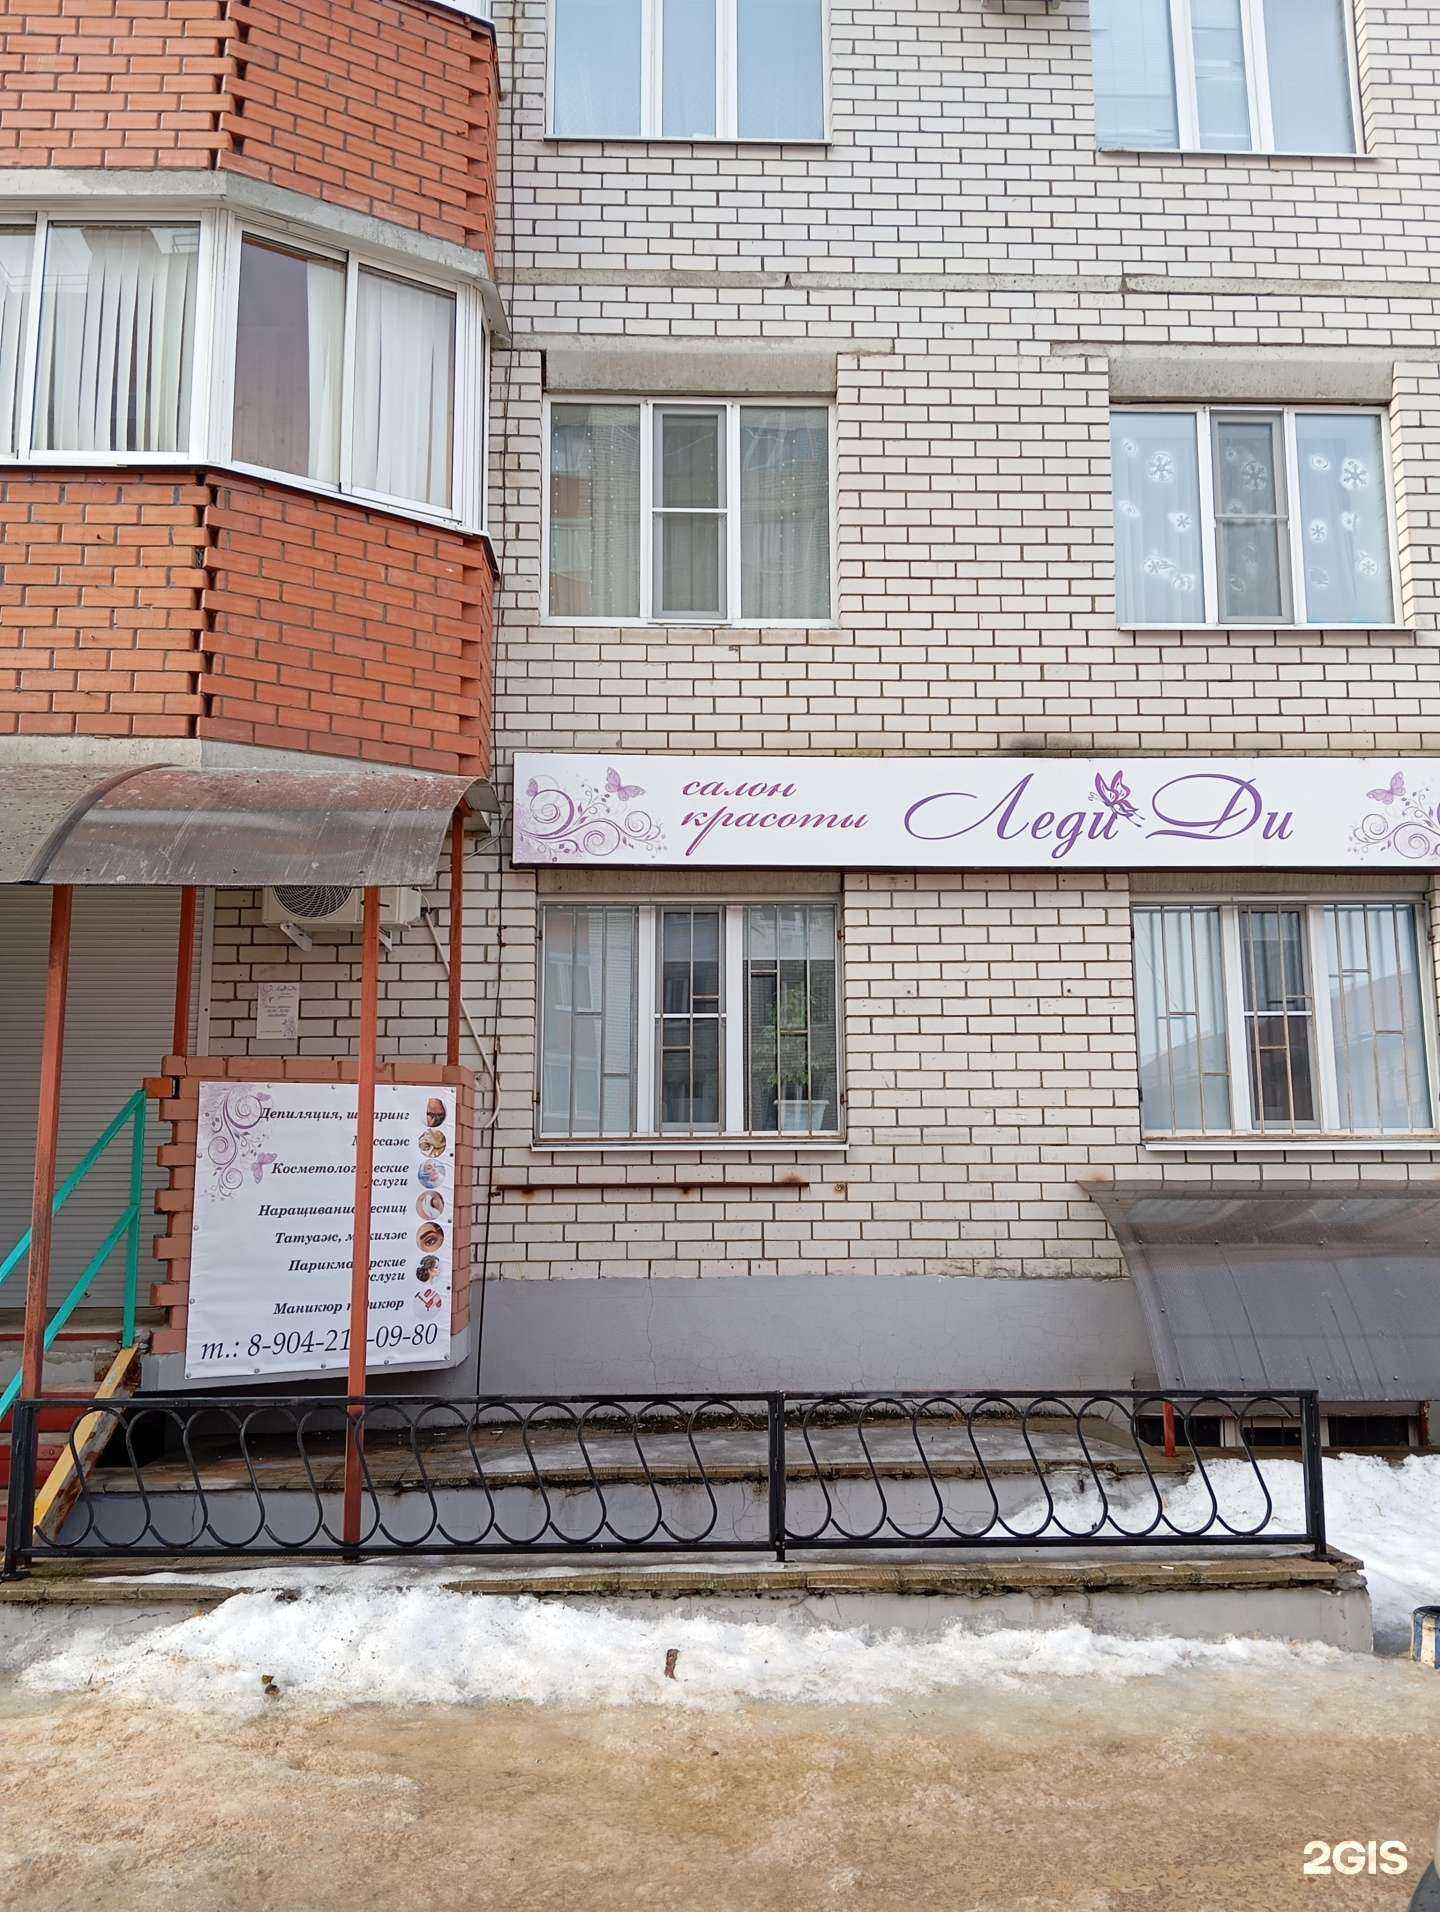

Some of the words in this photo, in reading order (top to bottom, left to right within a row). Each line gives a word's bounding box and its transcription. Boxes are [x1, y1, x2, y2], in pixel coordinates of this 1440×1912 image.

[682, 780, 797, 797] салон
[904, 773, 1118, 859] Леди
[1145, 773, 1294, 840] Ди
[681, 806, 868, 856] красоты
[259, 1107, 343, 1121] Депиляция,
[272, 1163, 410, 1174] Косметологеские
[370, 1178, 408, 1188] слуги
[370, 1204, 407, 1215] есниц
[275, 1232, 342, 1244] Татуаж,
[288, 1258, 407, 1271] Парикмарские
[367, 1272, 406, 1283] слуги
[273, 1302, 343, 1314] Маникюр
[247, 1323, 438, 1357] 8-904-21-09-80
